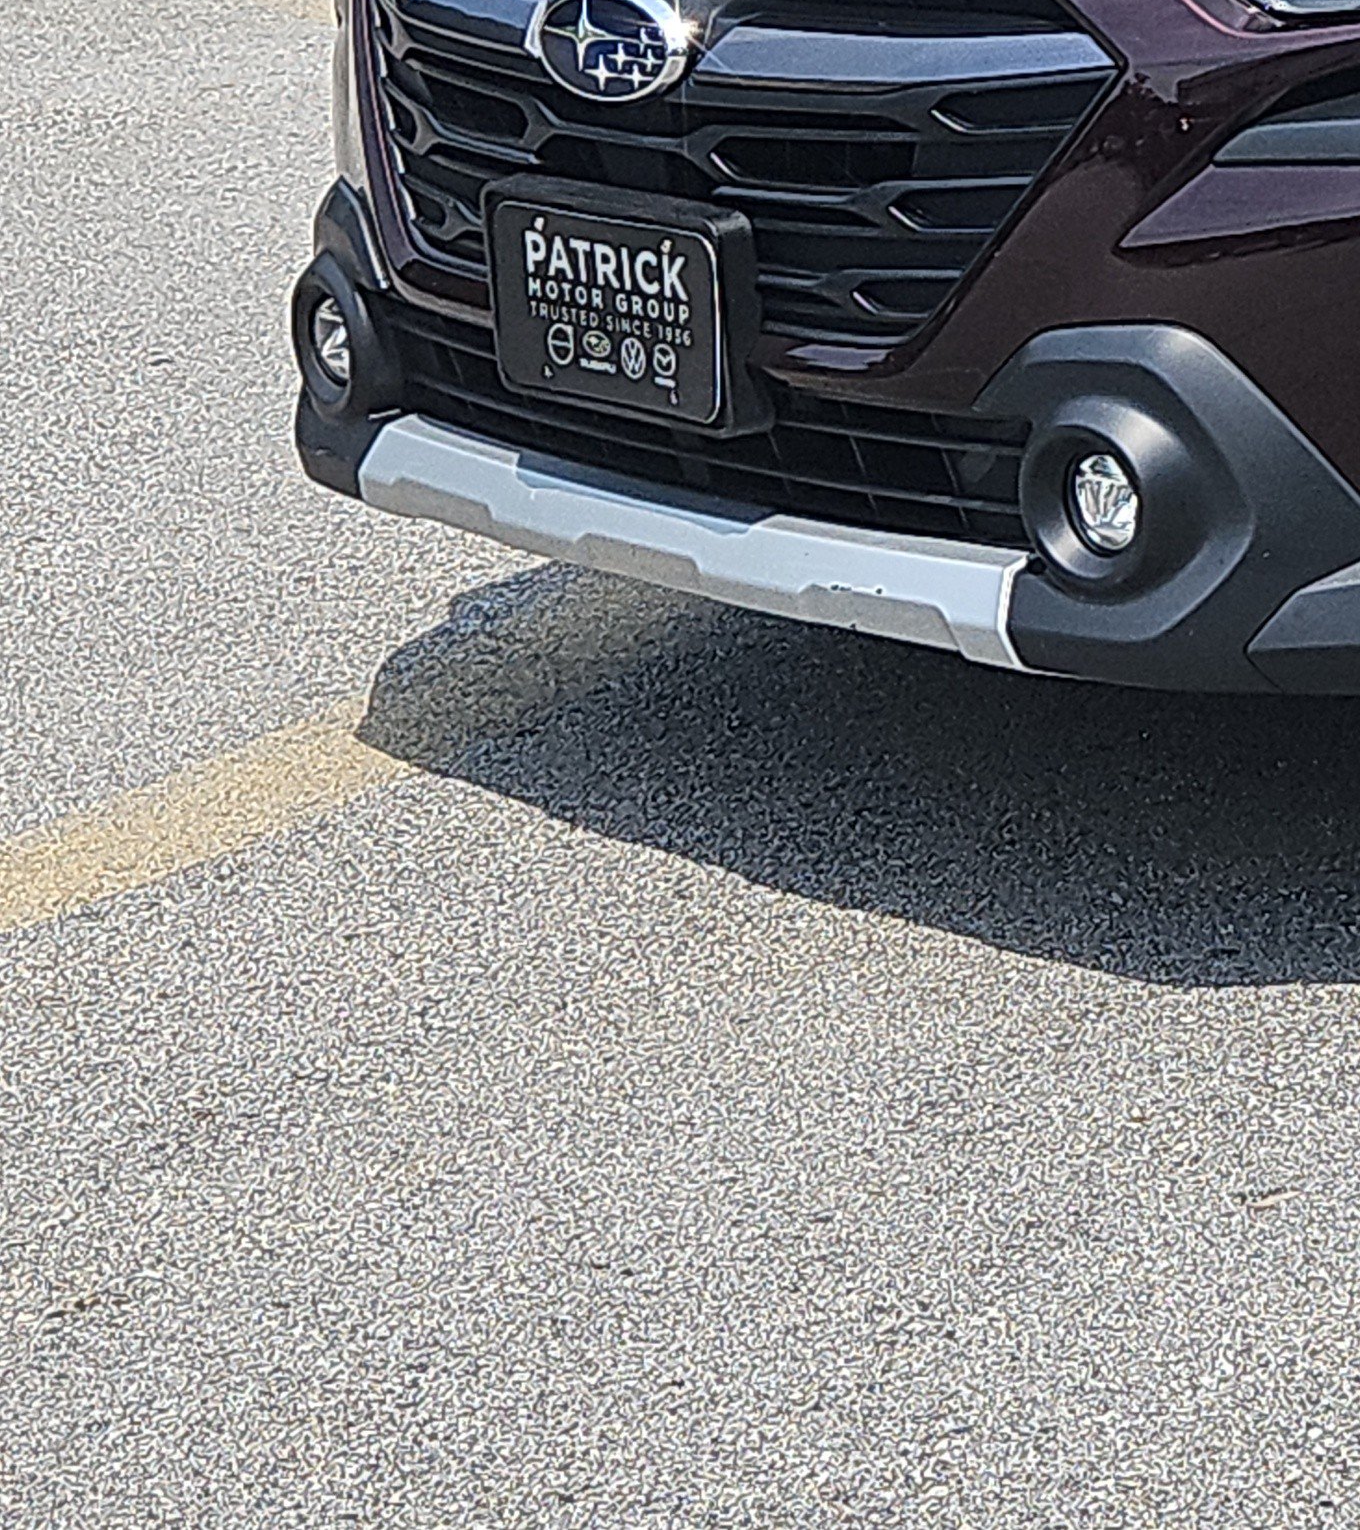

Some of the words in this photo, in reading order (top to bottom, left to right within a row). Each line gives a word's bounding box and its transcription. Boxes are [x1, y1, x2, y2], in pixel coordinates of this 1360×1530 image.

[524, 230, 689, 302] PATRICK
[528, 276, 603, 309] MOTOR
[615, 293, 690, 324] GROUP
[530, 301, 600, 329] TRUSTED
[606, 315, 651, 338] SINCE
